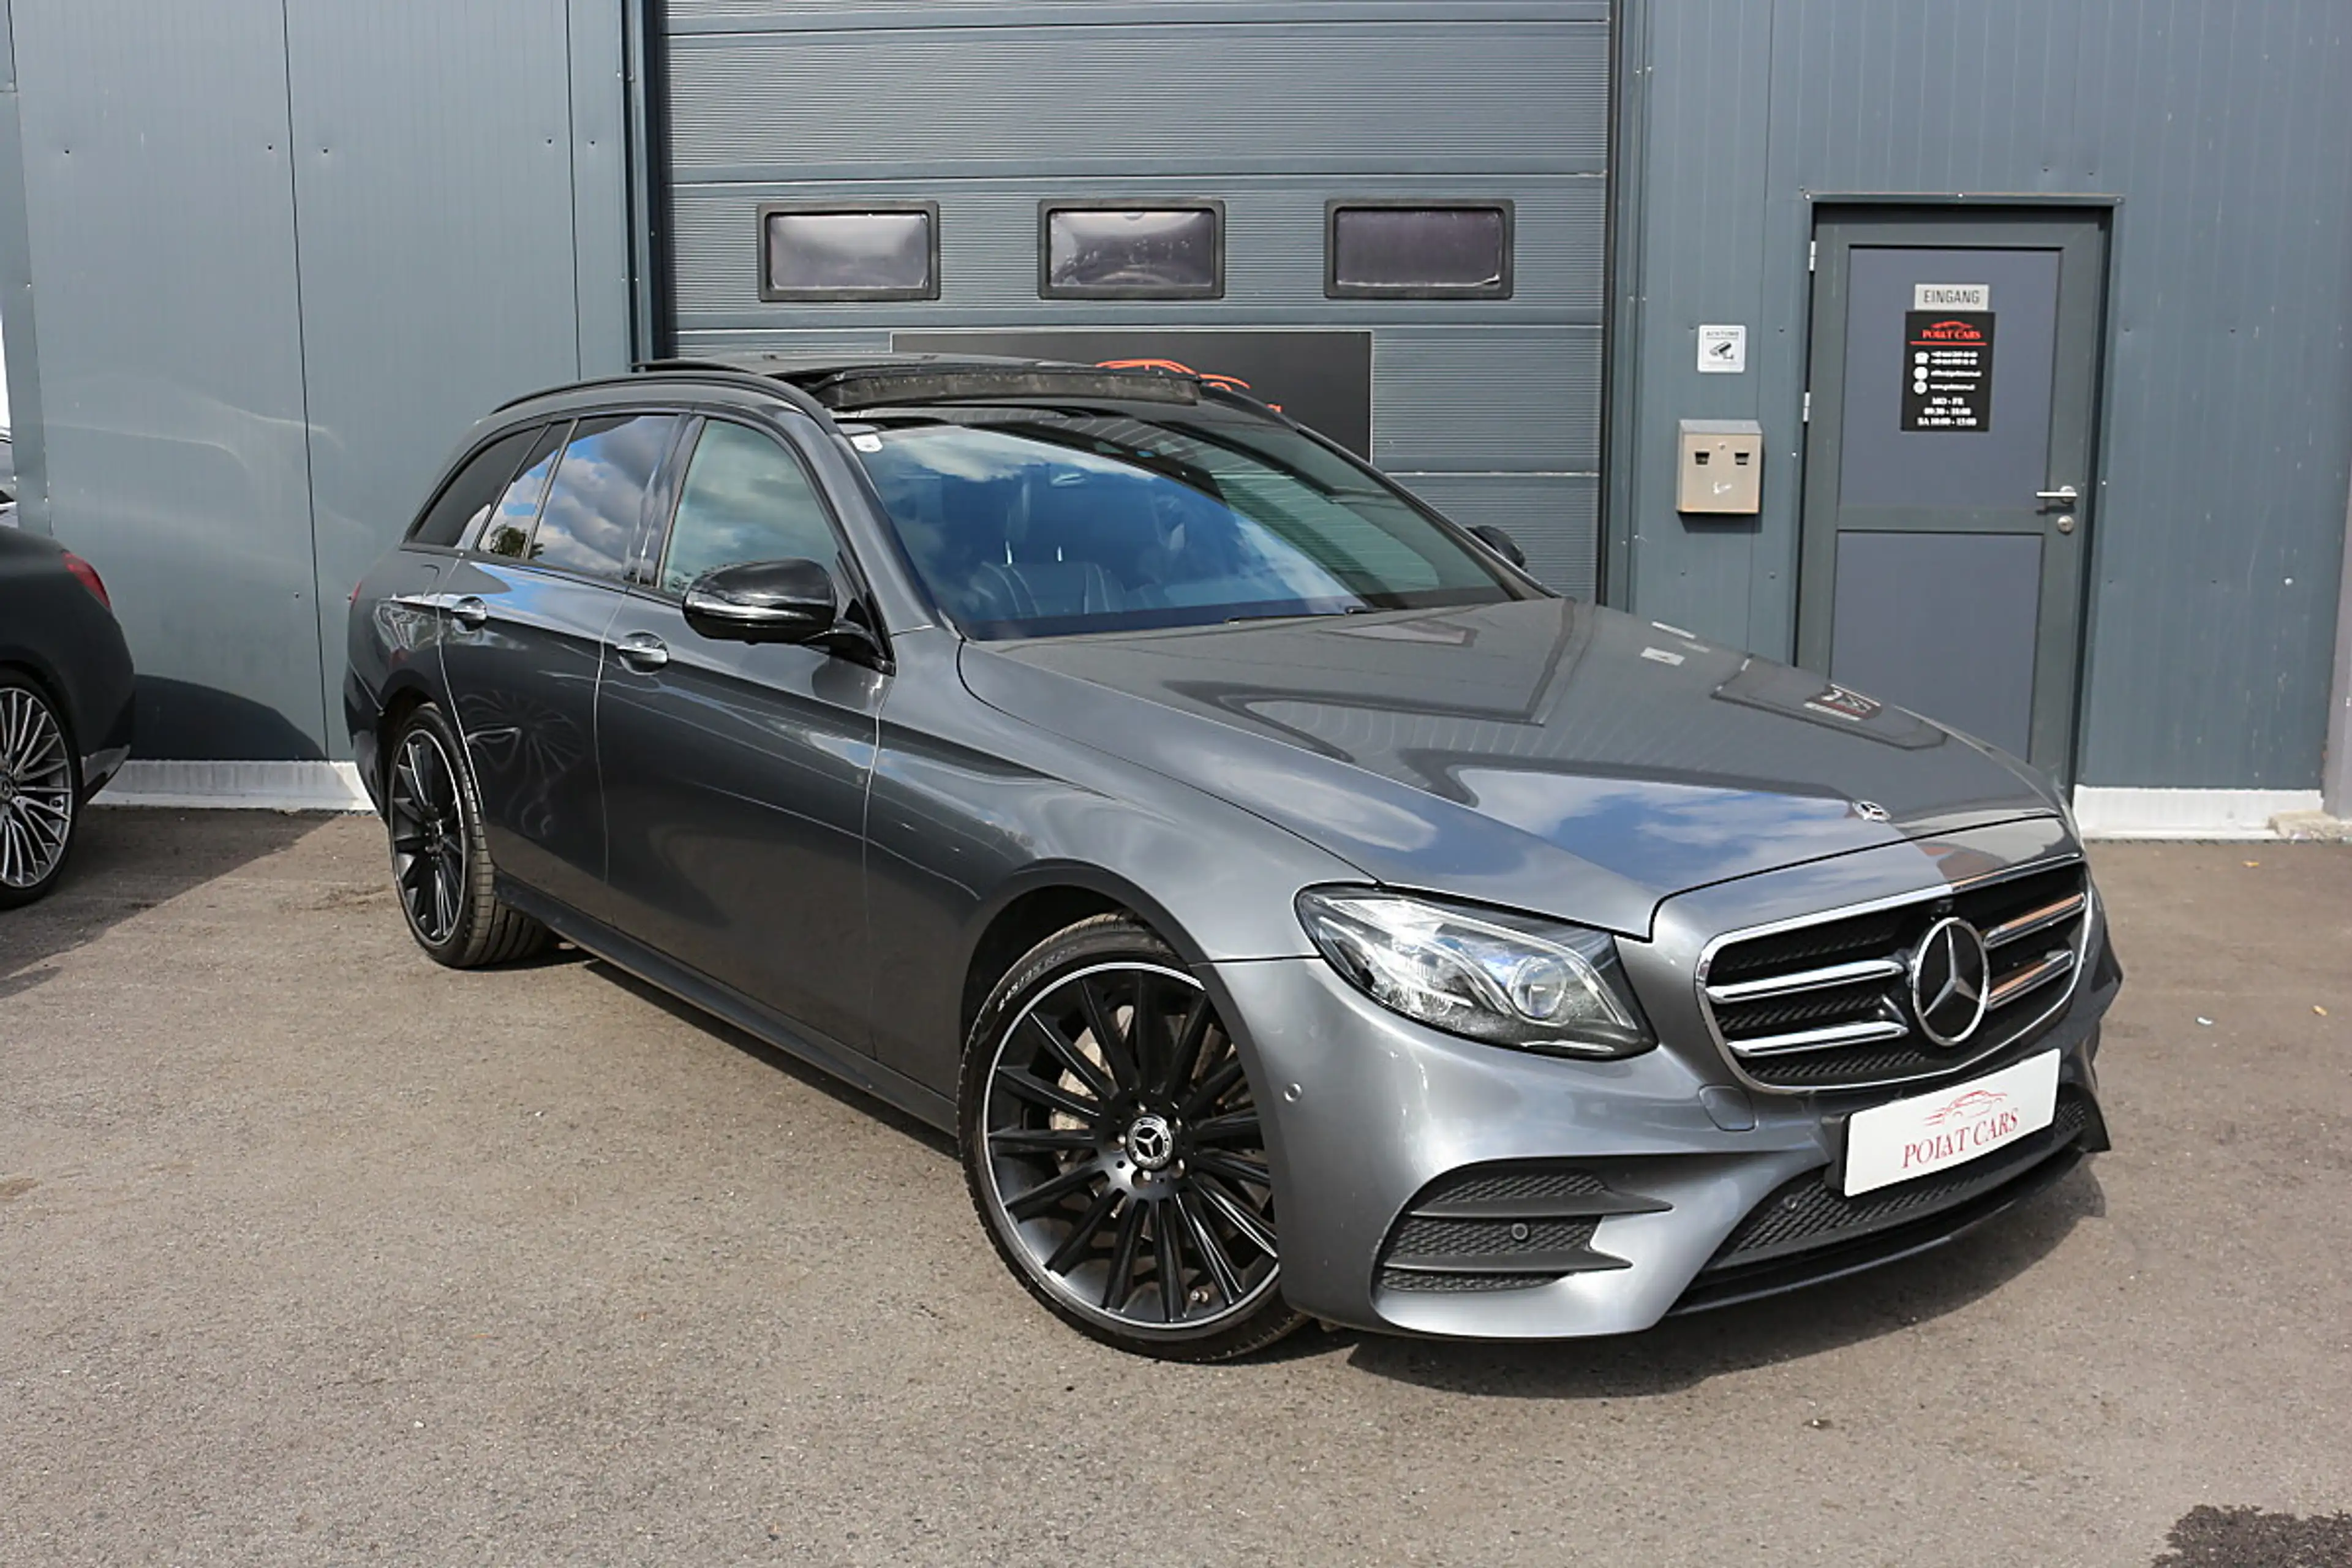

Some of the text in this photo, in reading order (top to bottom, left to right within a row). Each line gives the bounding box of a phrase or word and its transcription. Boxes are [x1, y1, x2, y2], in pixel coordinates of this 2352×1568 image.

[1923, 290, 1980, 304] EINGANG
[1954, 330, 1981, 339] CARS
[1973, 1107, 2019, 1146] CARS
